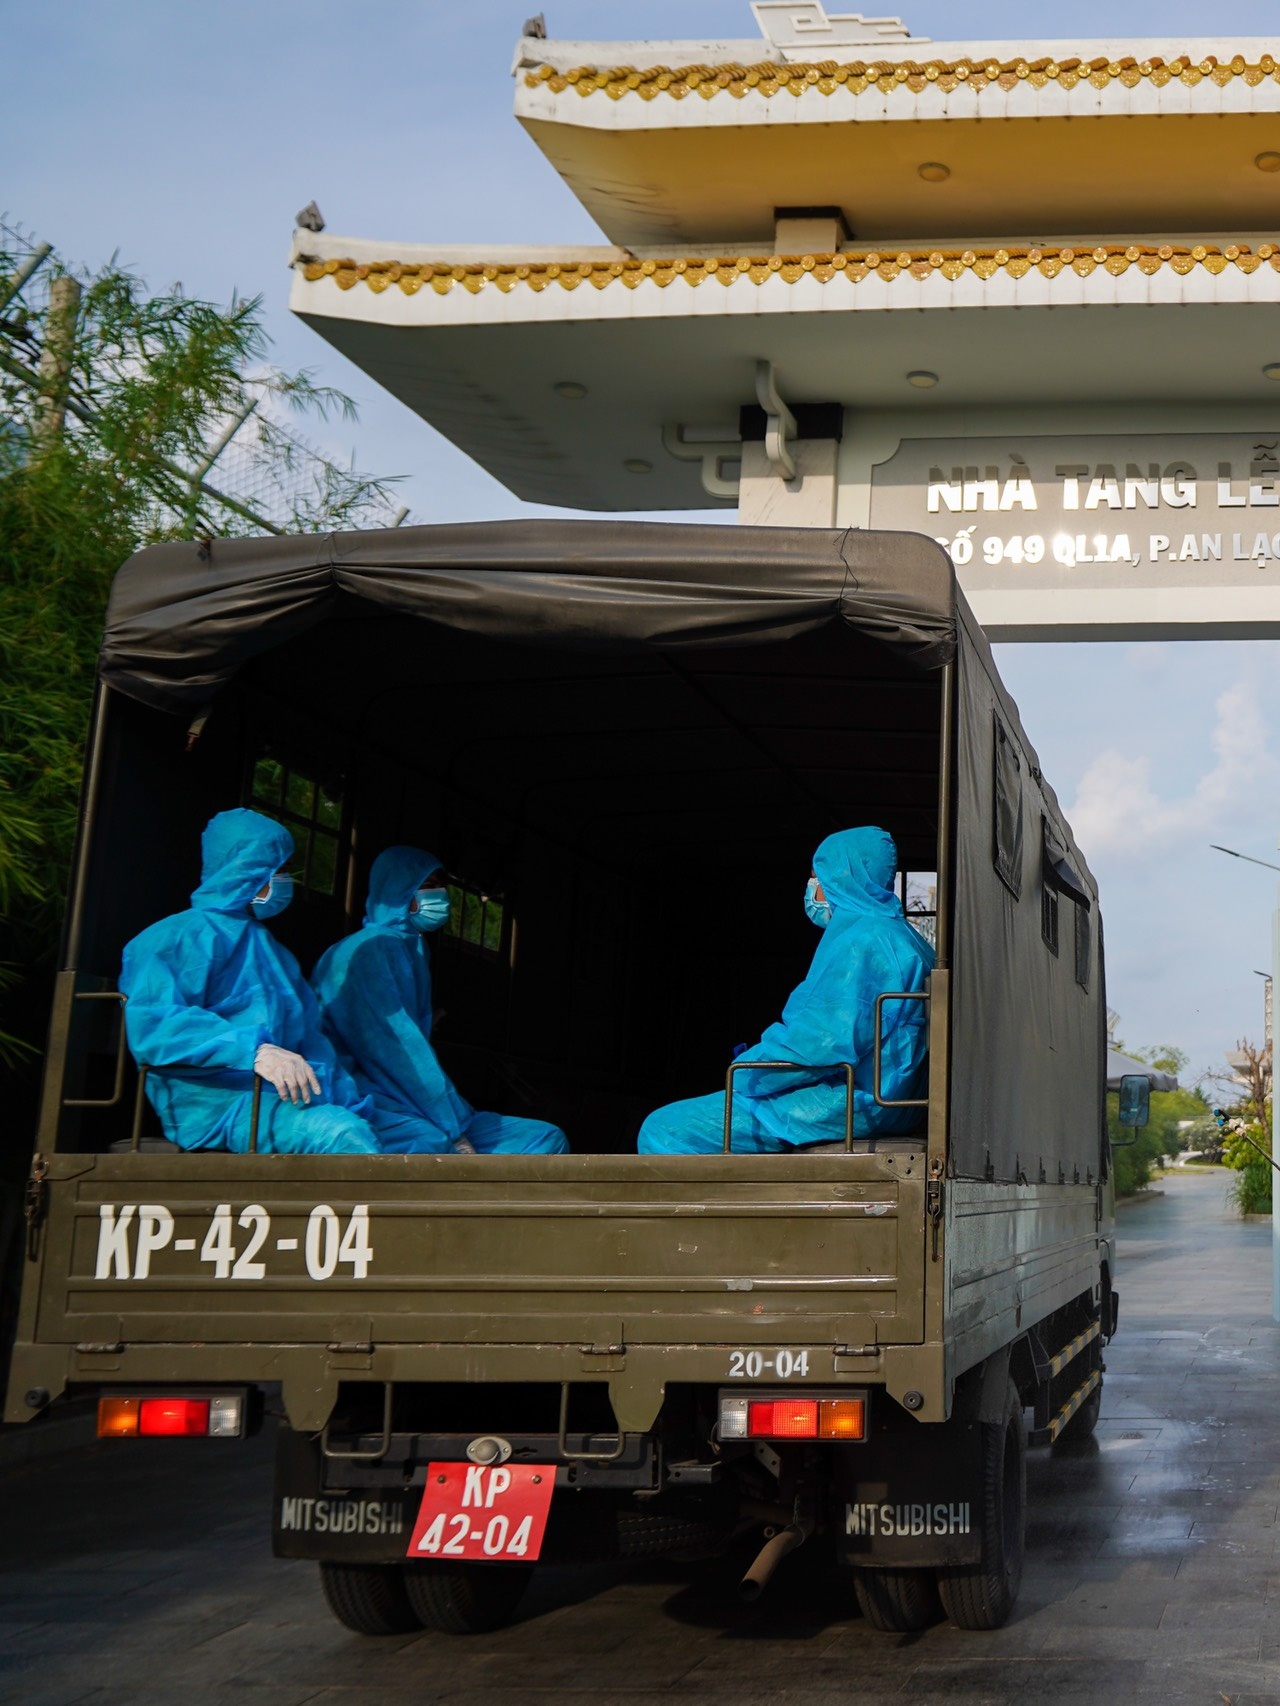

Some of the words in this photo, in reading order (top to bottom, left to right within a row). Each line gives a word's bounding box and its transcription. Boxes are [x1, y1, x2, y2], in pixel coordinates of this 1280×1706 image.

[927, 453, 1038, 513] NHÀ
[1055, 461, 1197, 510] TANG
[1217, 440, 1280, 507] LỄ
[983, 534, 1045, 565] 949
[1149, 533, 1222, 562] P.AN
[94, 1203, 374, 1281] KP-42-04
[728, 1351, 810, 1378] 20-04
[461, 1465, 511, 1509] KP
[281, 1496, 403, 1535] MITSUBISHI
[417, 1512, 533, 1557] 42-04
[845, 1502, 971, 1537] MITSUBISHI
